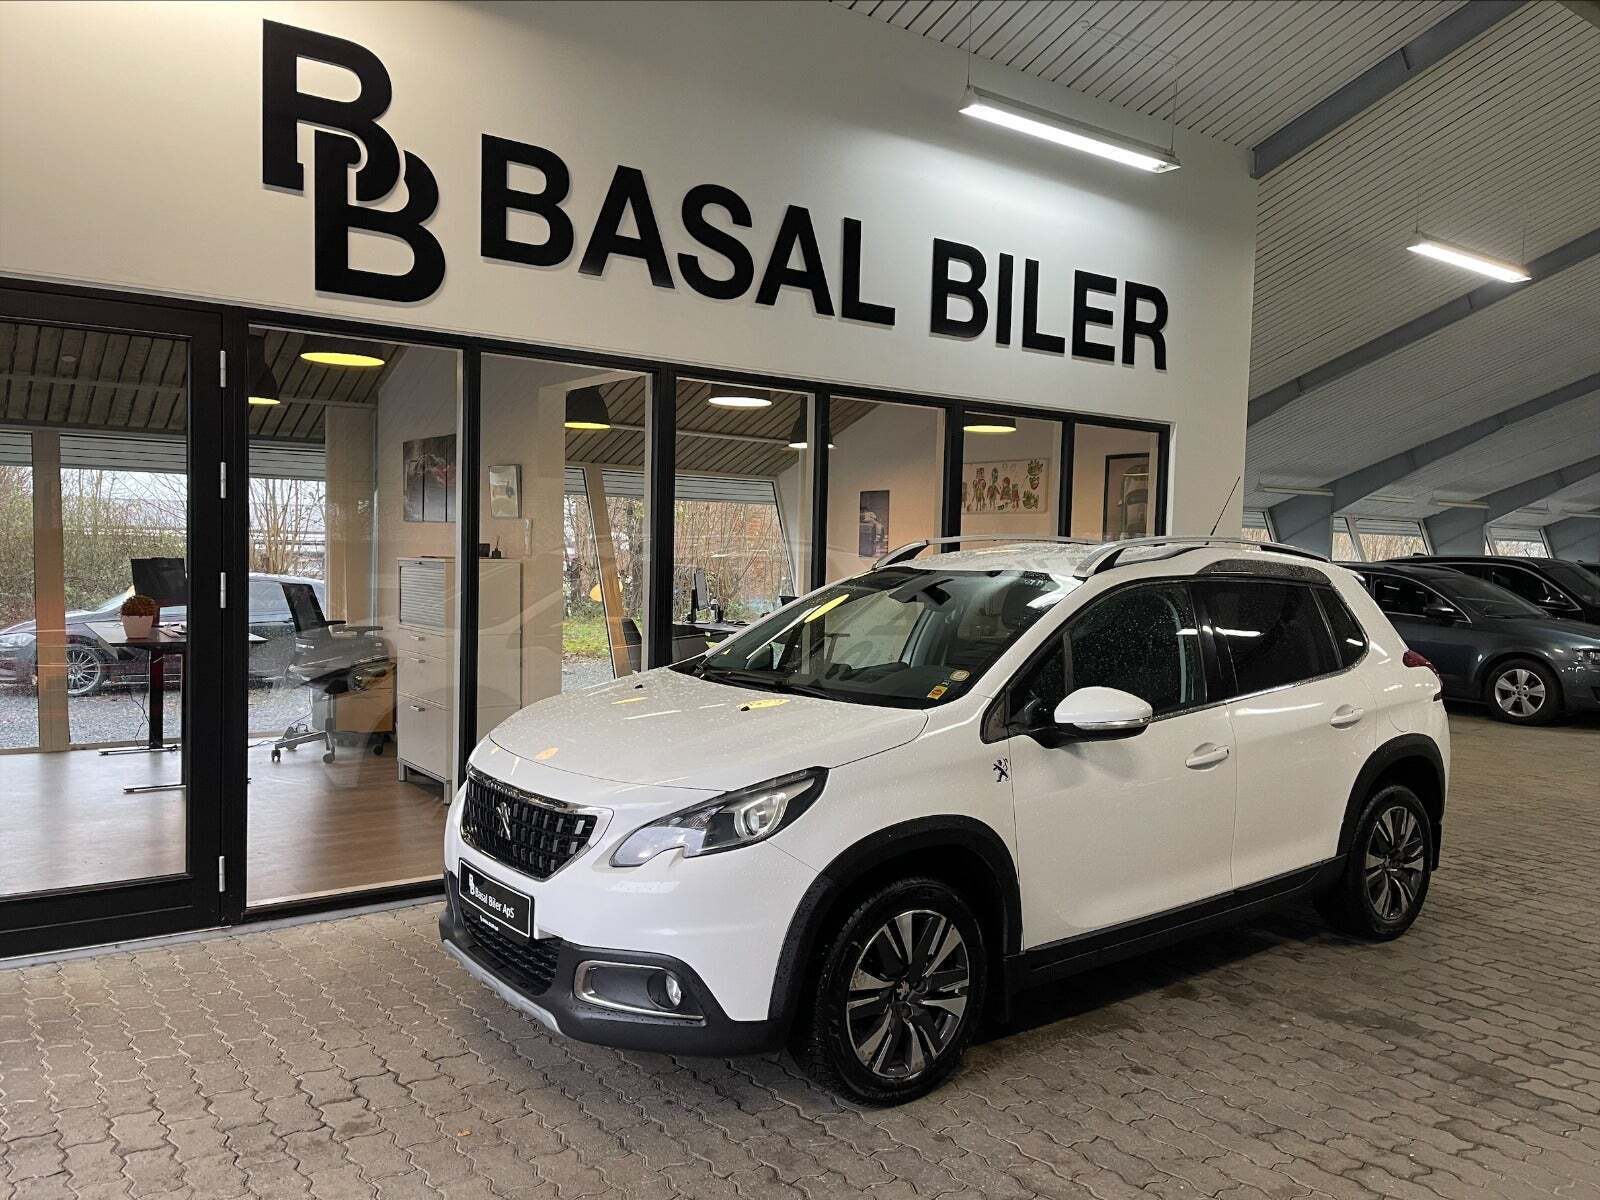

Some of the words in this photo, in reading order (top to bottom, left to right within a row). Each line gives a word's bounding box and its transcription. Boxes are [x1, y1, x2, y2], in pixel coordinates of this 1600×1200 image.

[480, 133, 896, 327] BASAL
[930, 237, 1169, 371] BILER
[475, 887, 488, 904] Basal
[488, 895, 502, 912] Biler
[502, 903, 515, 919] ApS
